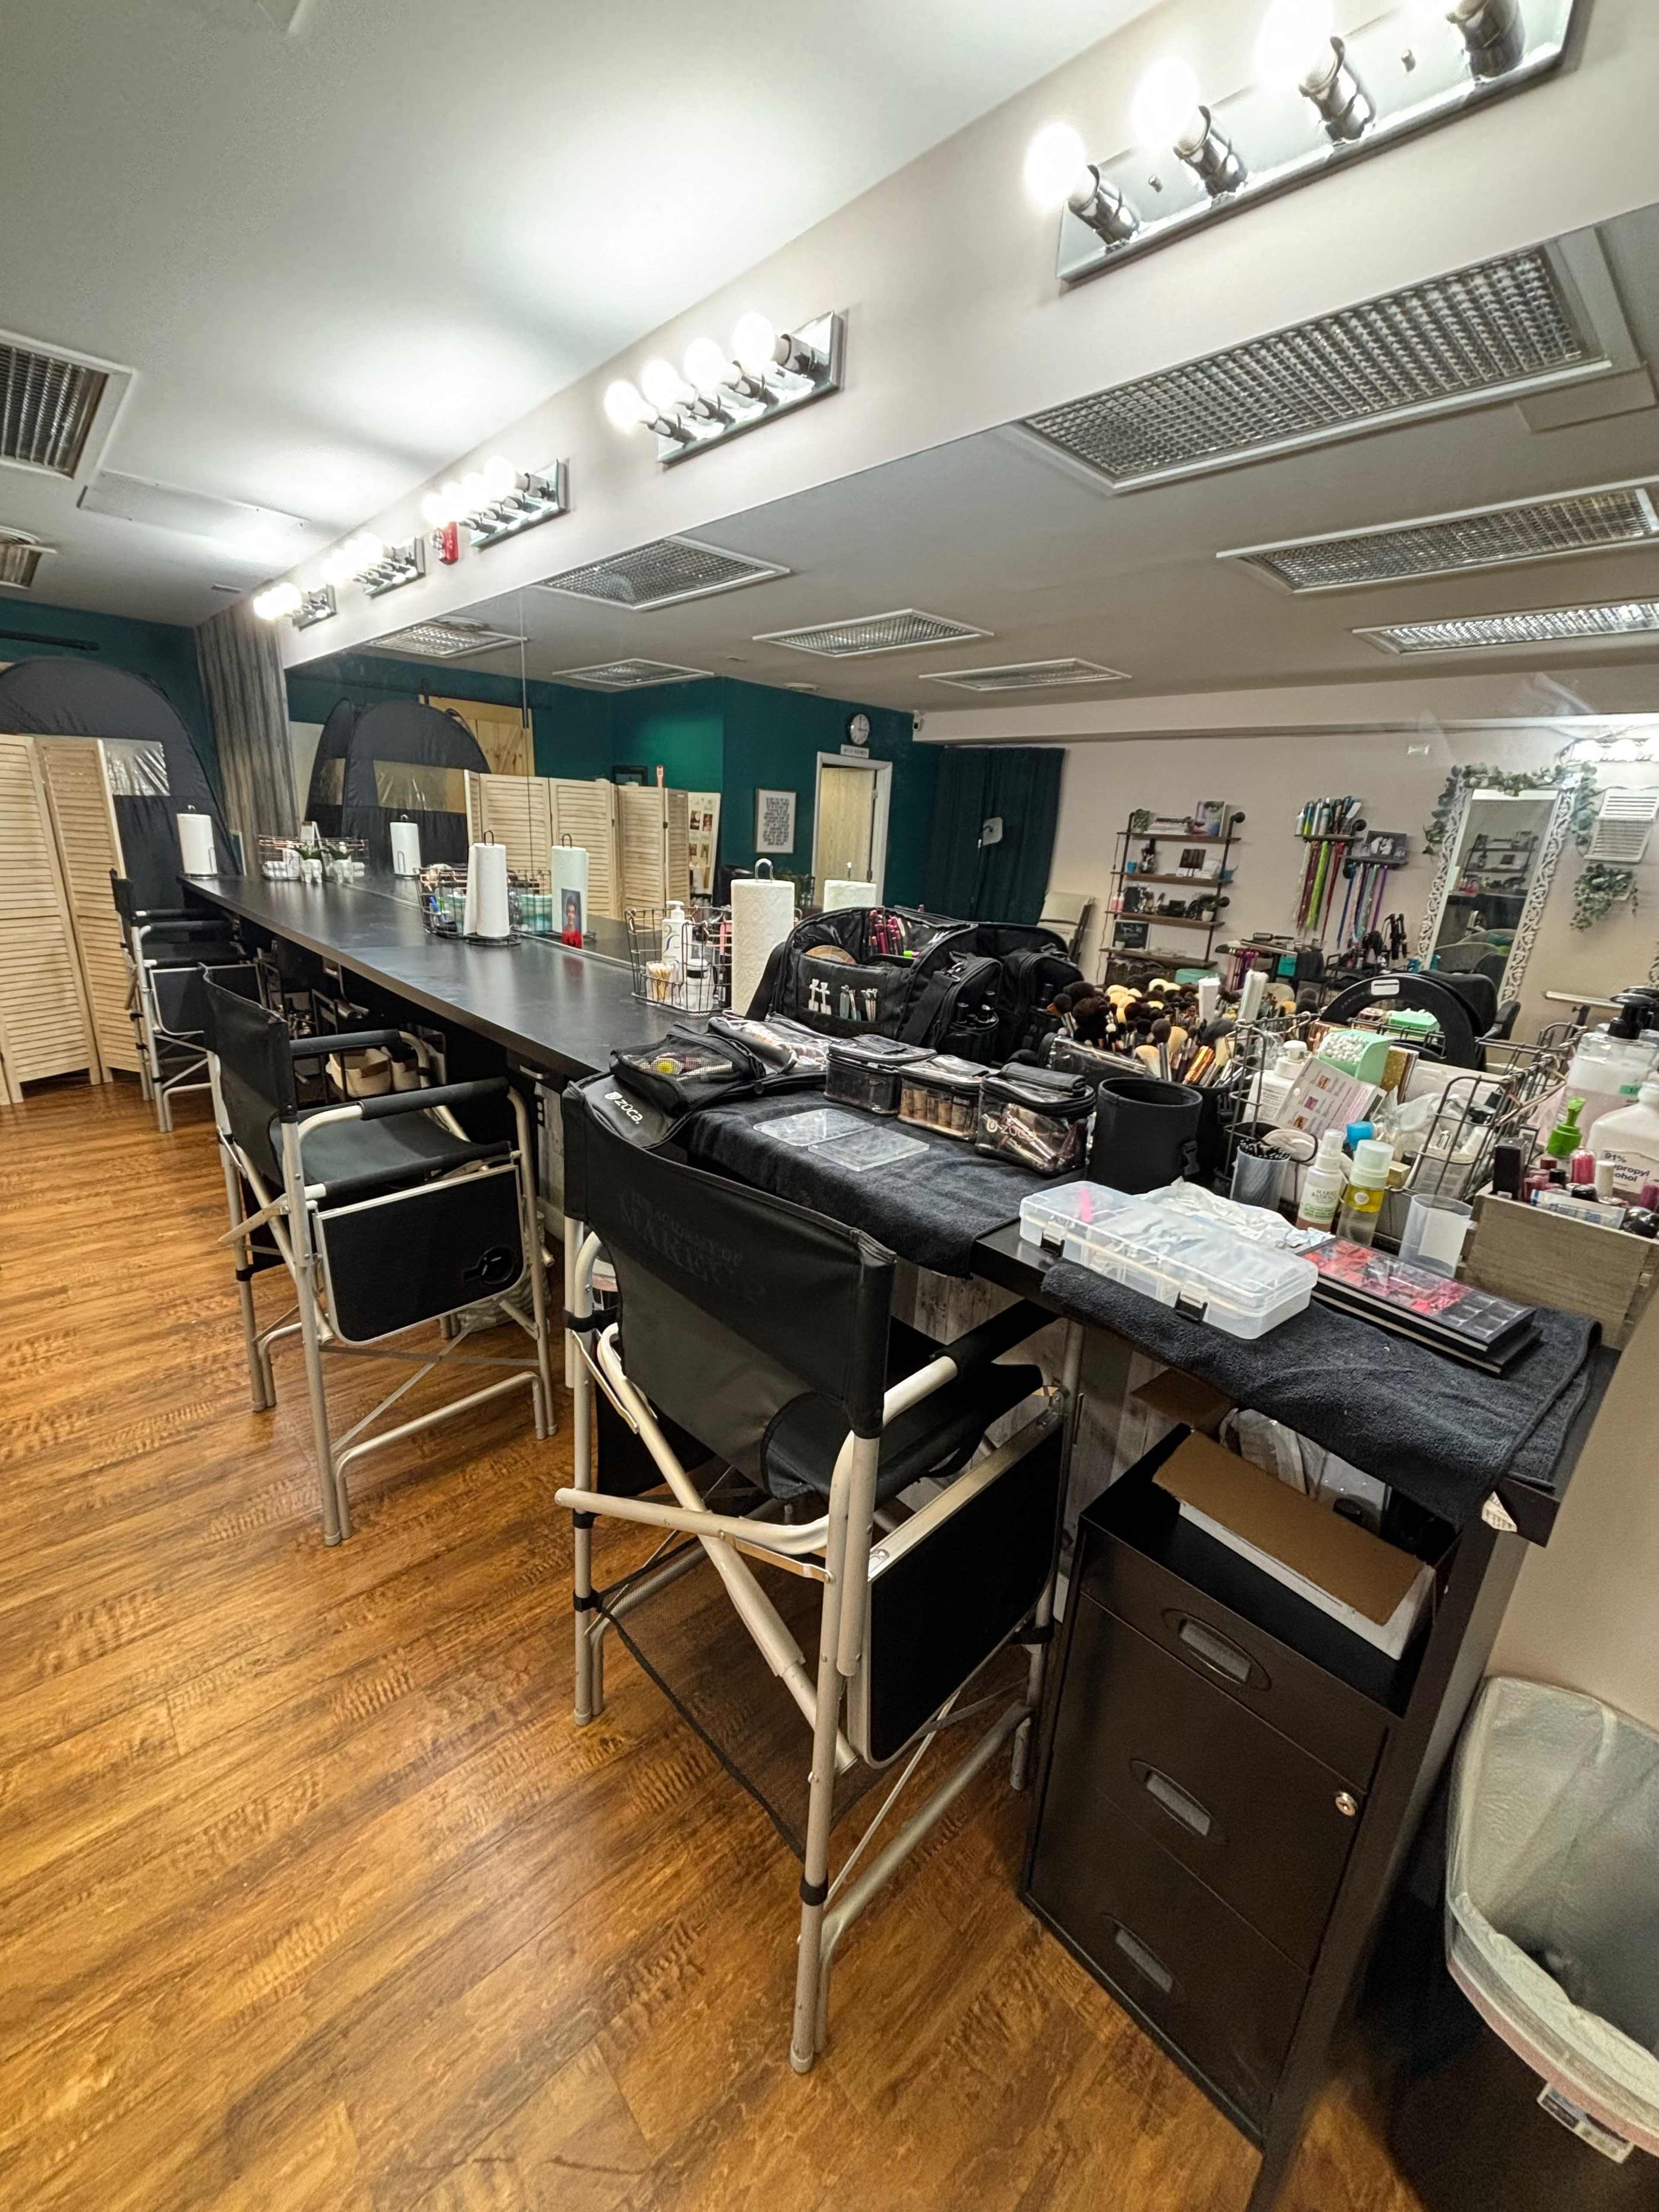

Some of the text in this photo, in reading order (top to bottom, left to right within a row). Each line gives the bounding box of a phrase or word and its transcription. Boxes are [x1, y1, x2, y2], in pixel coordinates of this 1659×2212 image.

[1605, 1152, 1627, 1163] 91%
[1615, 1164, 1650, 1177] propyl
[1615, 1173, 1638, 1182] ohol
